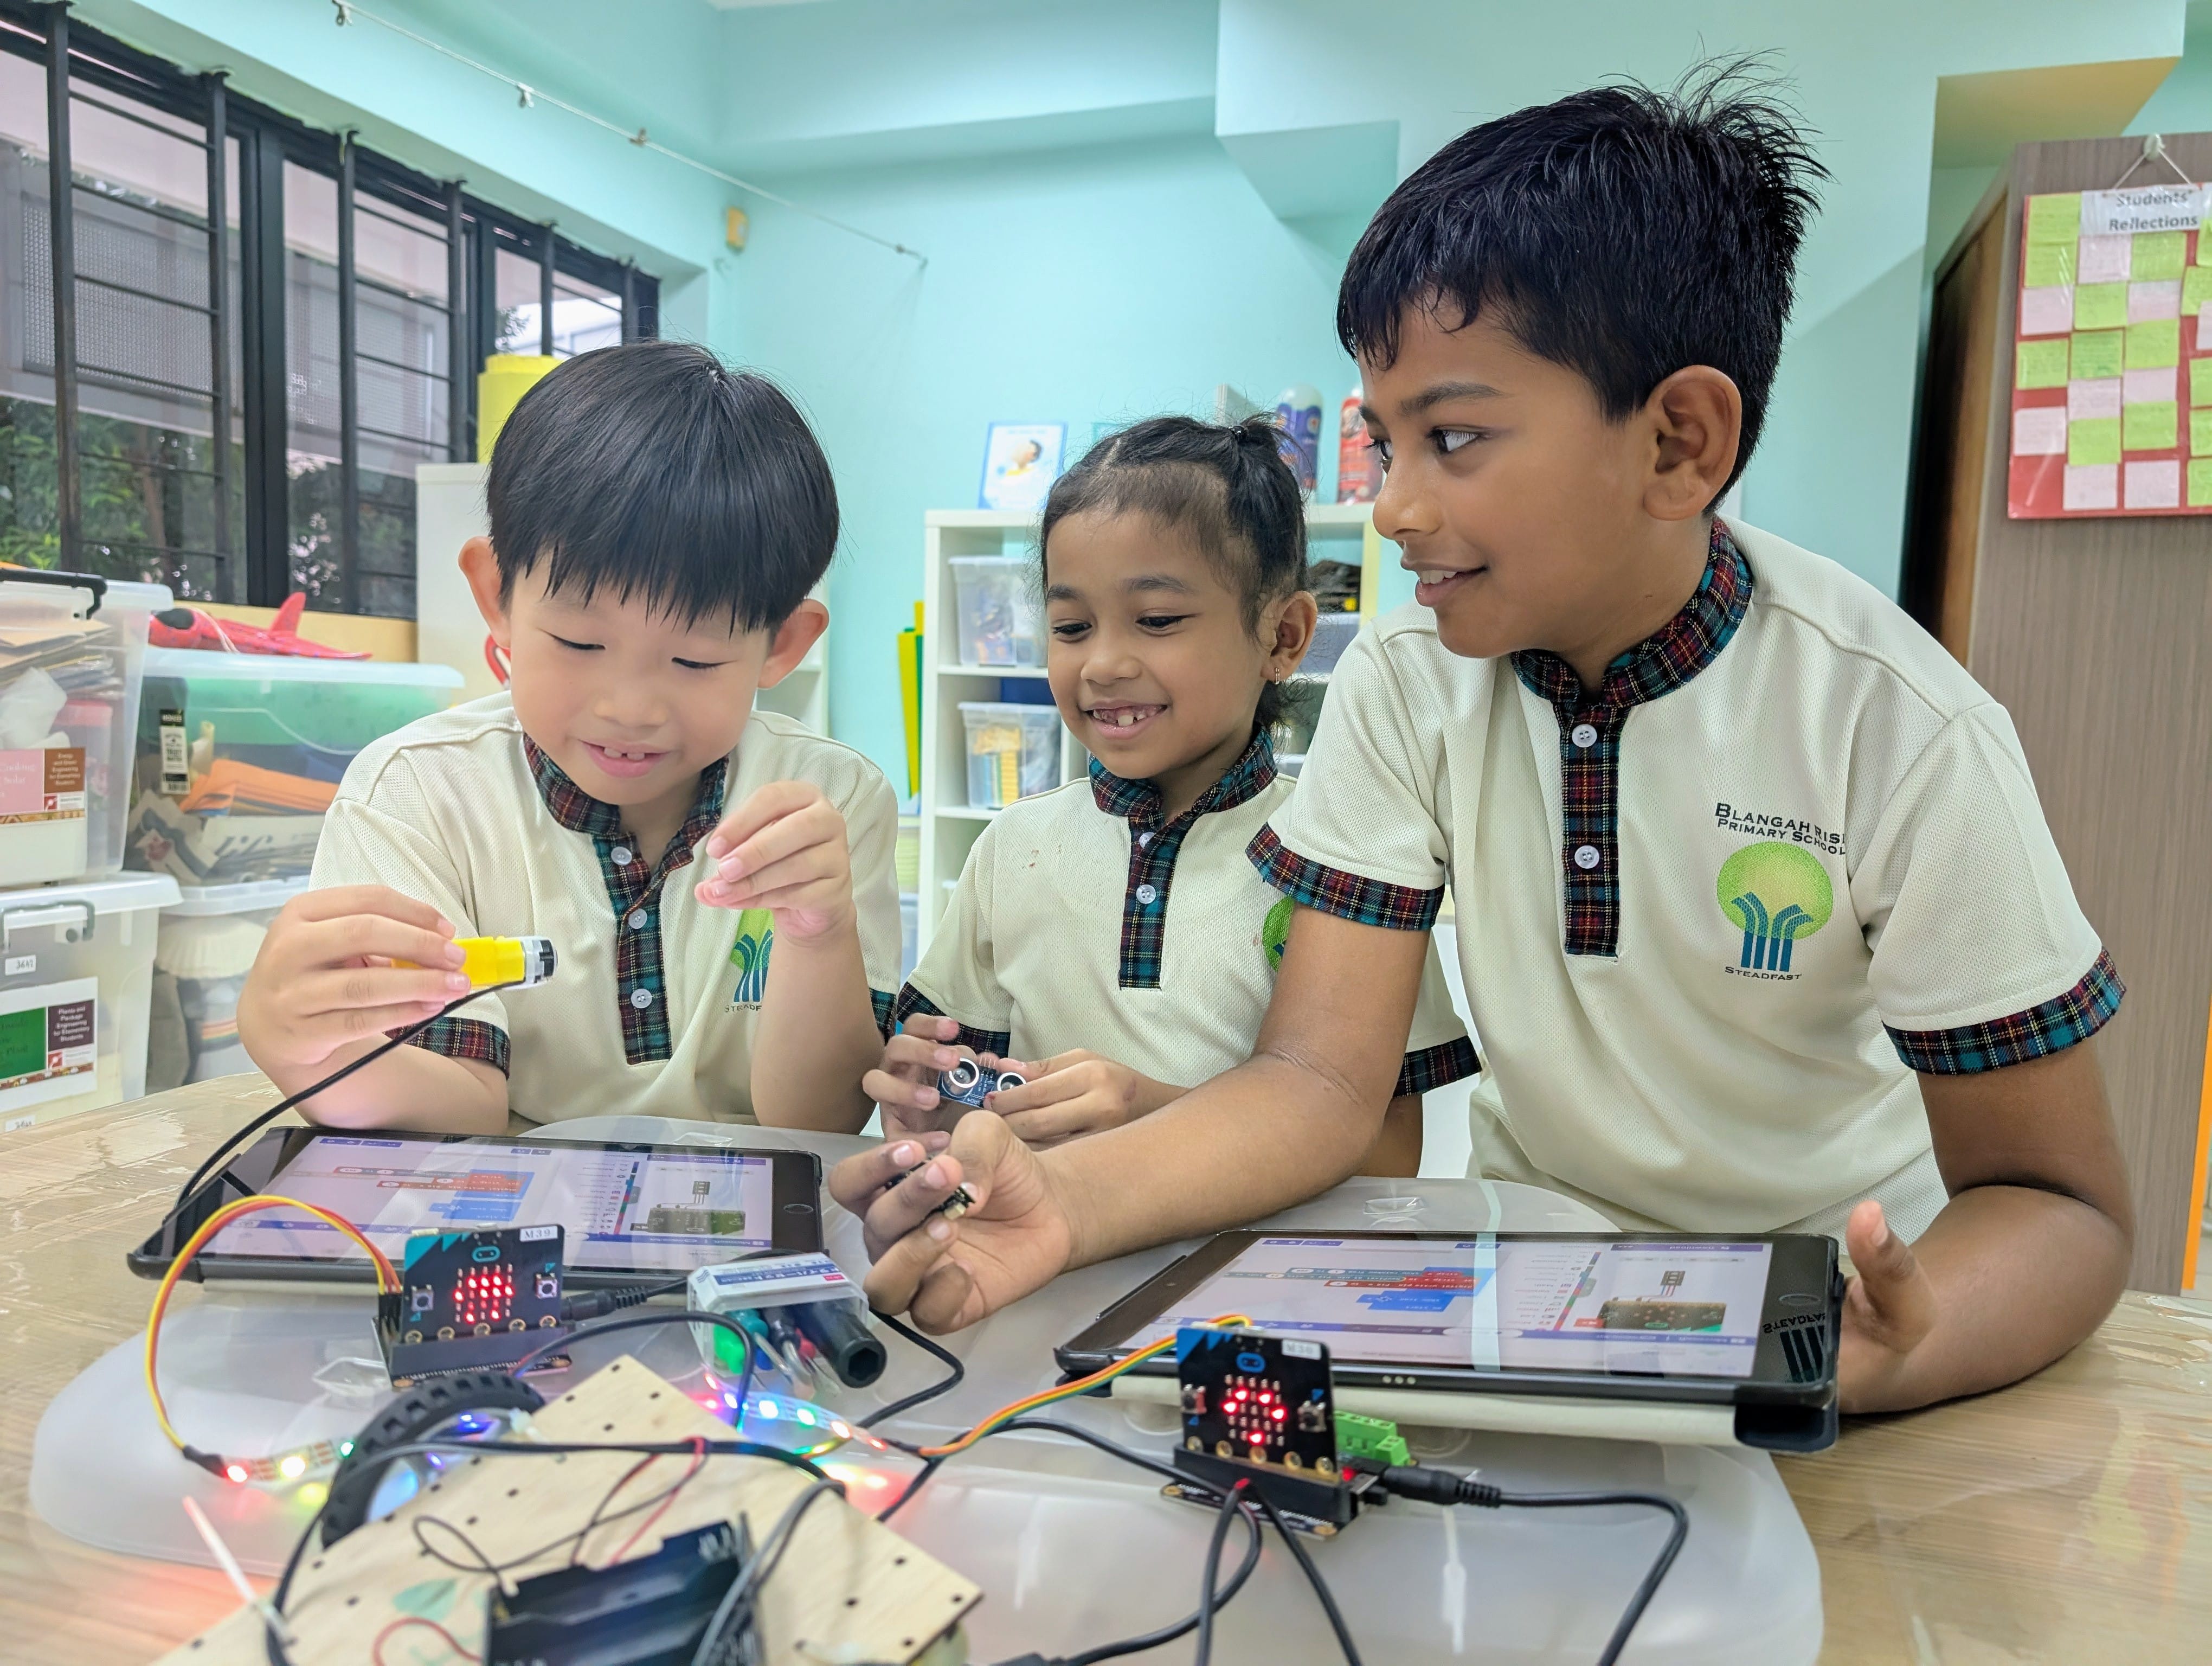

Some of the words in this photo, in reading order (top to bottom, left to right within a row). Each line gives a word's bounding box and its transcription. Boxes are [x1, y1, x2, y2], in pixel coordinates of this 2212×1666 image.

[2109, 215, 2198, 230] Reflections
[1715, 803, 1810, 832] BLANGAH
[1815, 824, 1844, 844] RIS
[1717, 818, 1787, 839] PRIMARY
[1792, 831, 1846, 855] SCHOOL
[1725, 966, 1802, 981] STEADFAST
[724, 1004, 762, 1013] STEADF
[525, 1228, 550, 1239] M39
